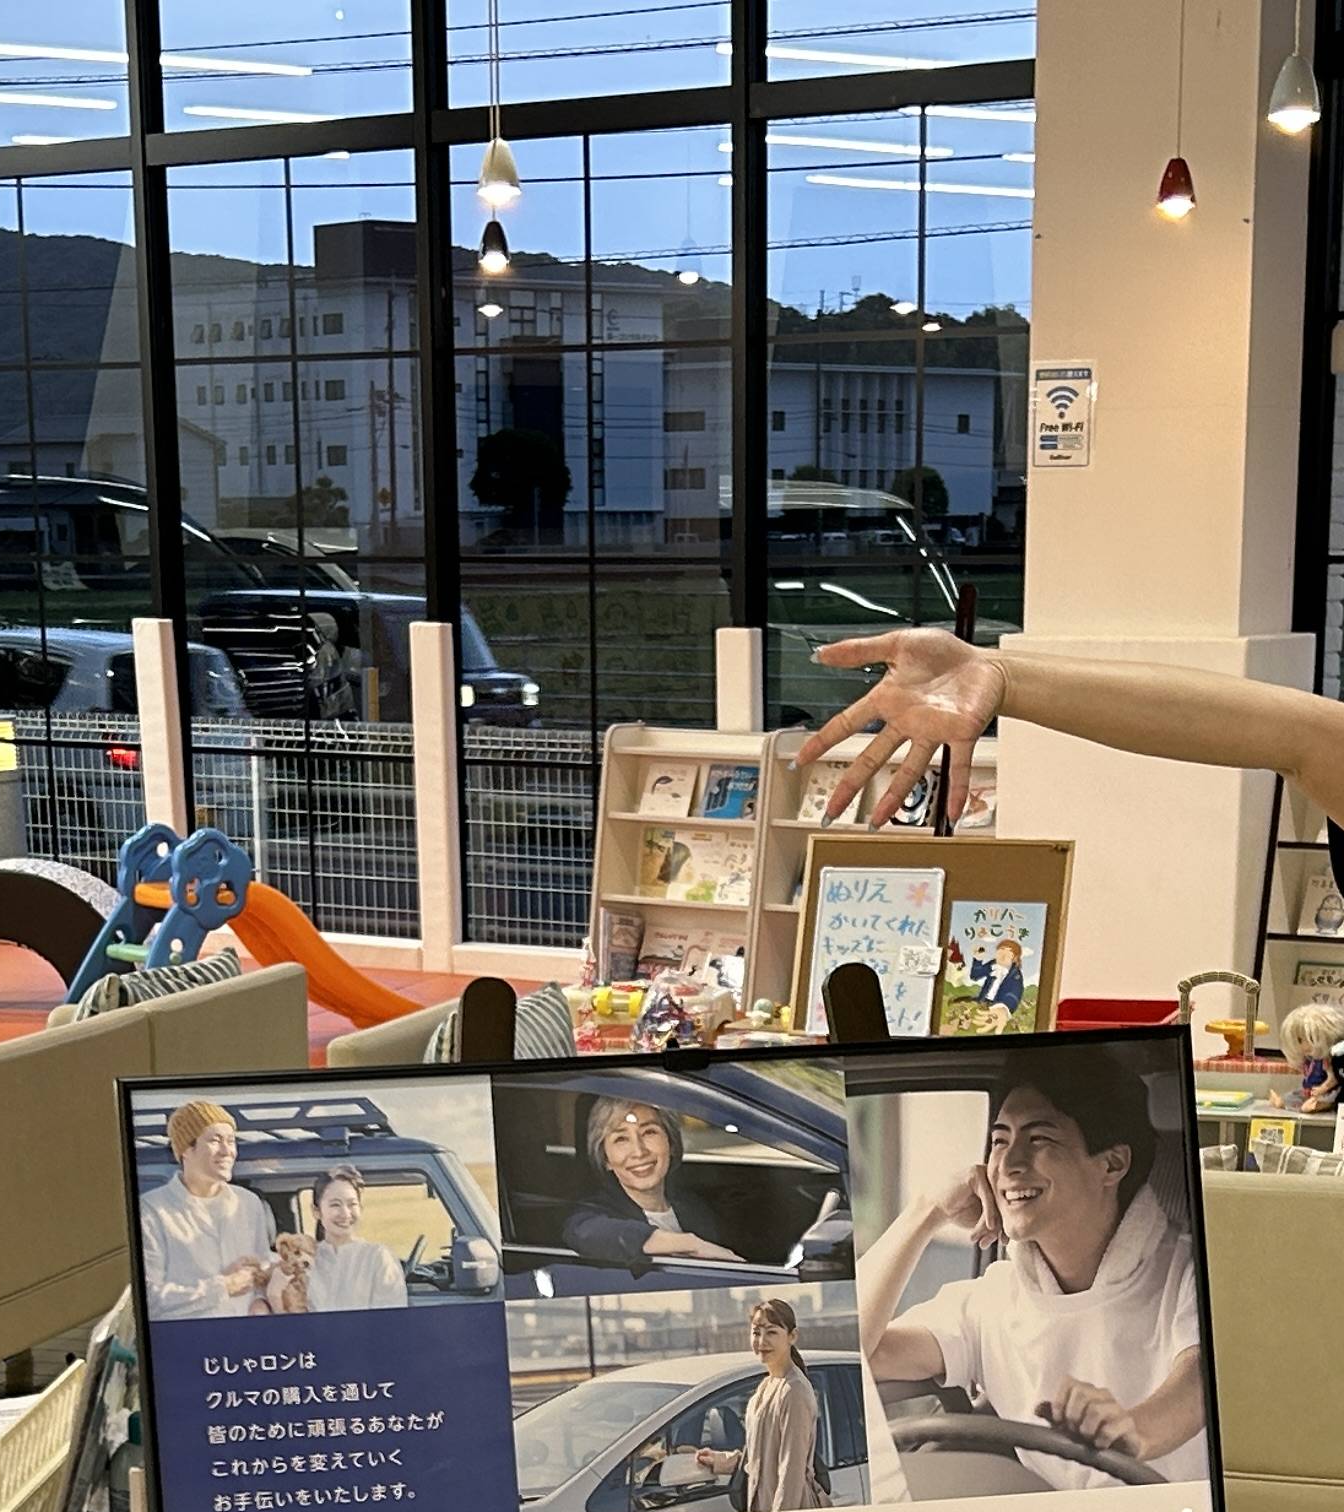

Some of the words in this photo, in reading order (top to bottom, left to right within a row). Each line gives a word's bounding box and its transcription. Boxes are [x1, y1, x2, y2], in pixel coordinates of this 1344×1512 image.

[826, 878, 893, 904] ぬりえ
[828, 913, 931, 938] かいてくれた
[203, 1352, 318, 1376] じしゃロンは
[206, 1381, 396, 1410] クルマの購入を通して
[207, 1410, 445, 1445] 皆のために頑張るあなたが
[210, 1449, 403, 1478] これからを変えていく
[213, 1482, 417, 1512] お手伝いをいたします。
